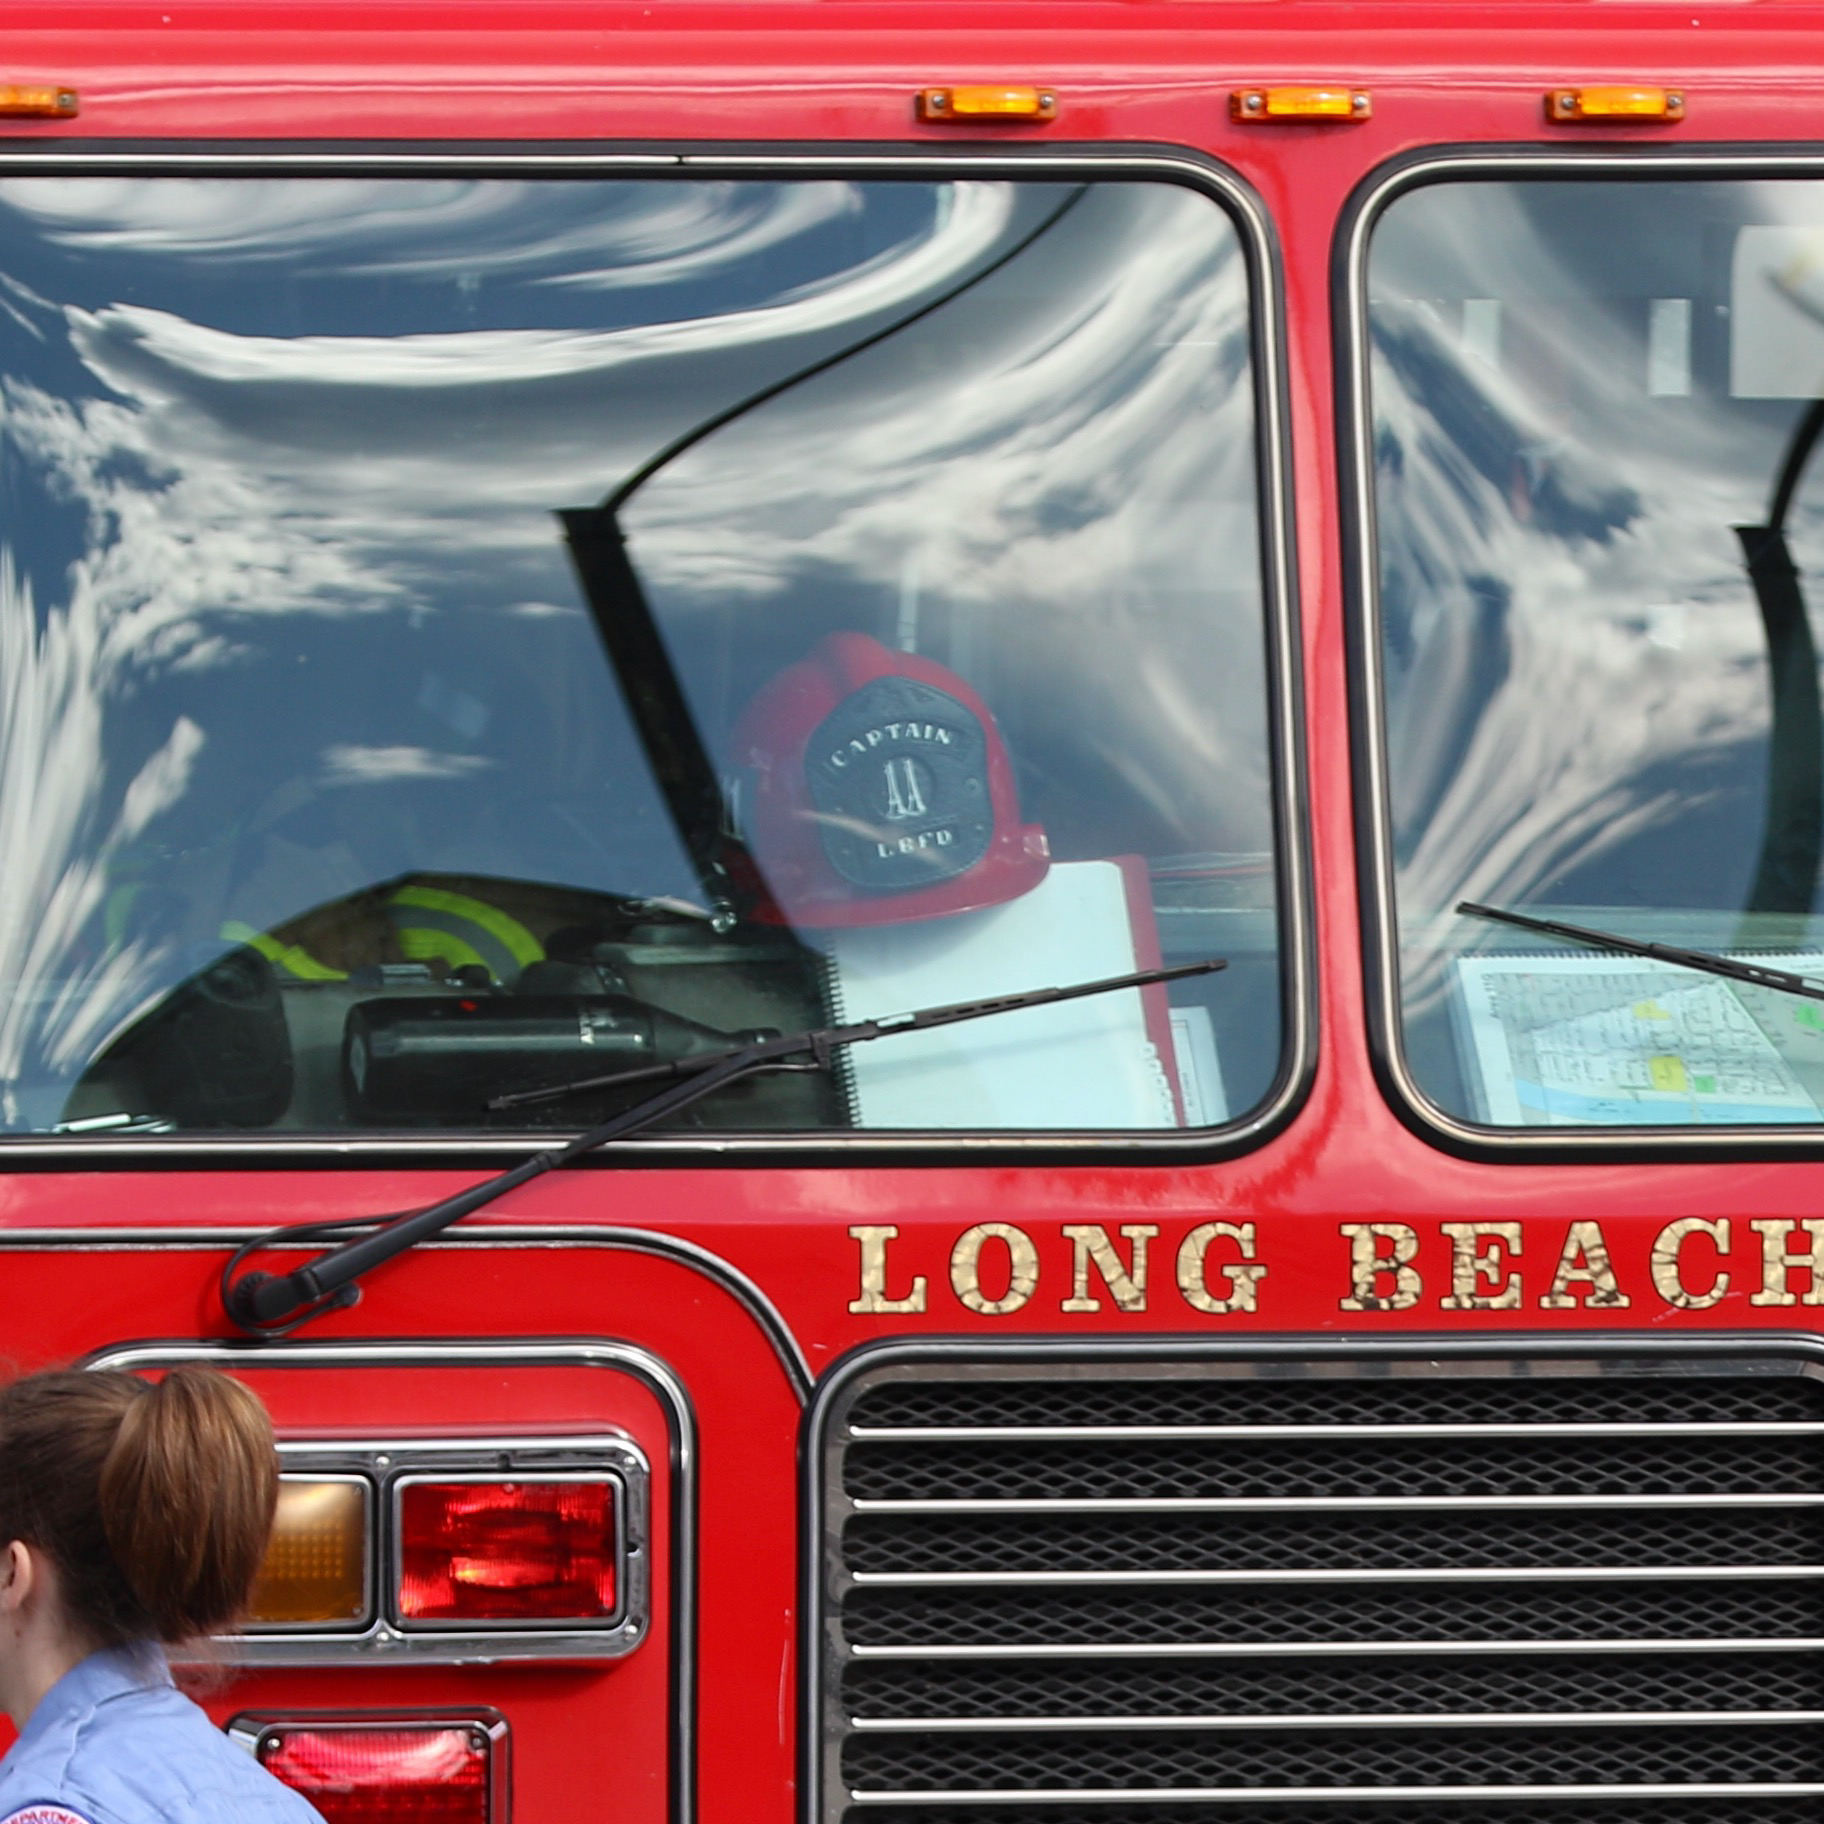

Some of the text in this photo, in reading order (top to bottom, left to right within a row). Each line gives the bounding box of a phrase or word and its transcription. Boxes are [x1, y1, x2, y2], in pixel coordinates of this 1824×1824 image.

[831, 722, 952, 766] CAPTAIN
[882, 757, 927, 820] 11
[847, 1221, 1270, 1315] LONG
